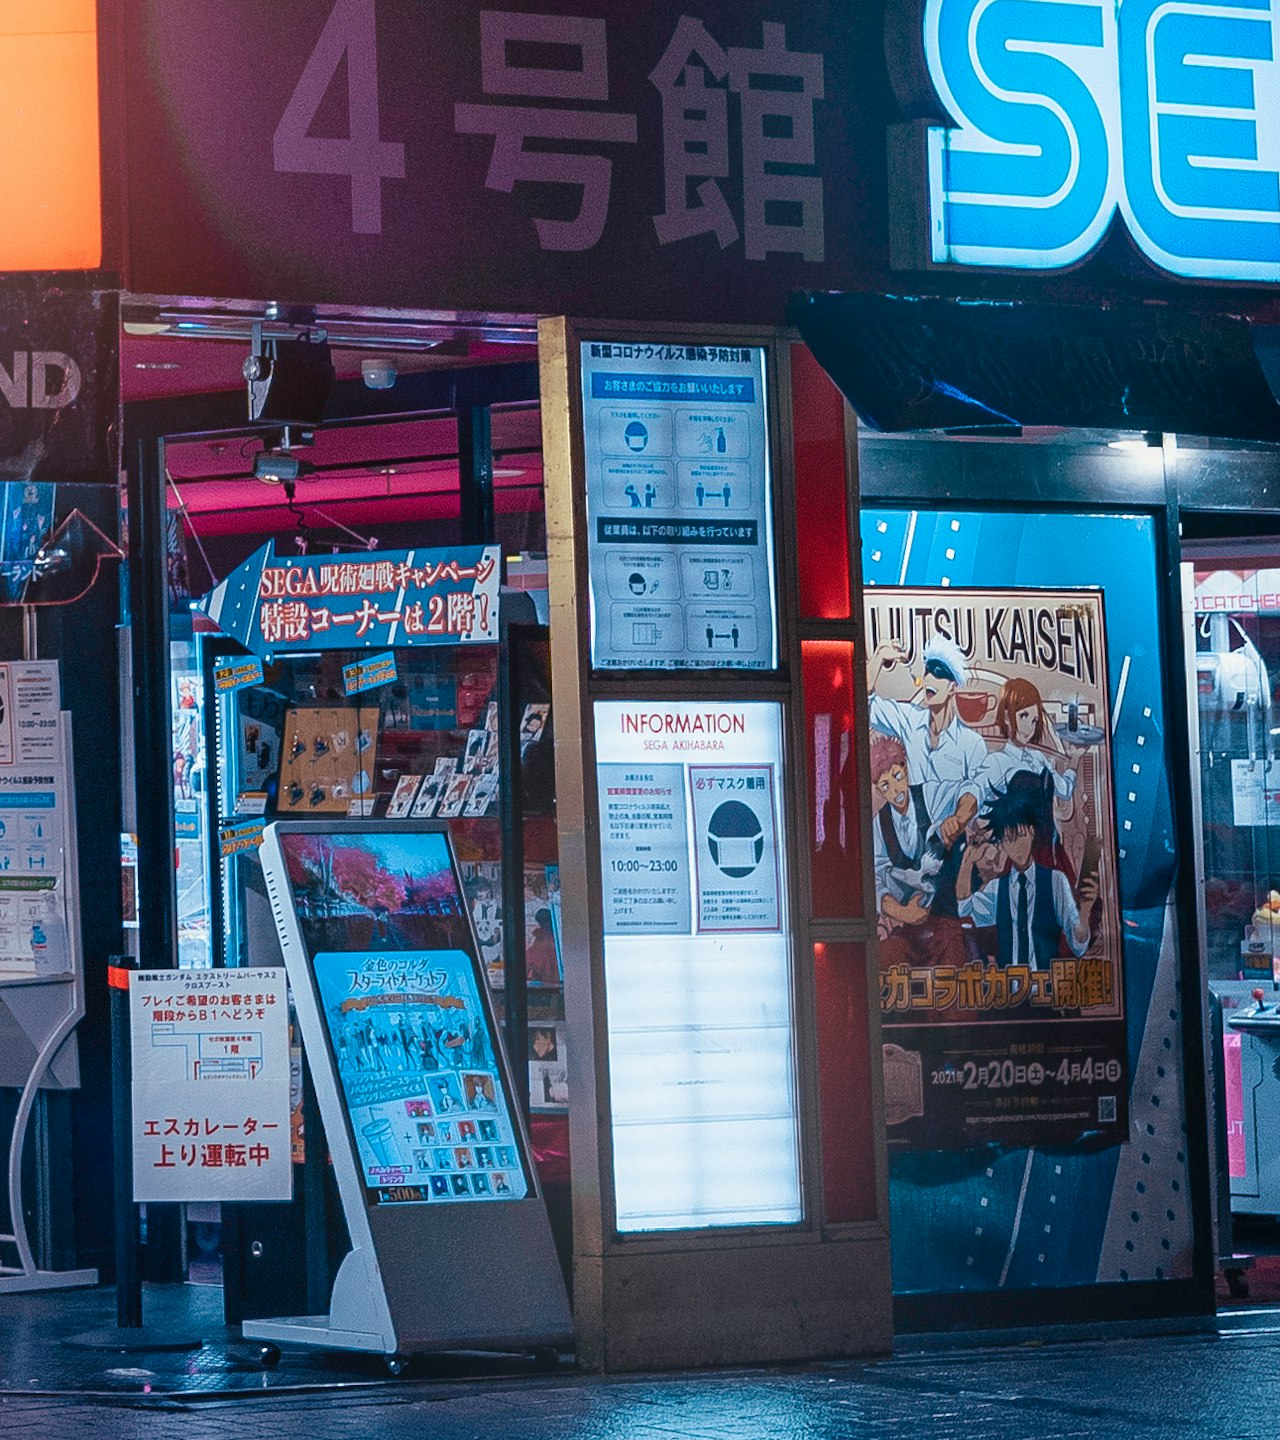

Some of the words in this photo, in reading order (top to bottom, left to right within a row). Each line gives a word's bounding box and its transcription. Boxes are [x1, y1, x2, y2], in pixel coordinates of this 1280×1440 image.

[986, 608, 1097, 685] KAISEN
[621, 713, 745, 734] INFORMATION
[643, 739, 668, 751] SEGA
[672, 739, 724, 751] AKIHABARA
[696, 777, 765, 790] 必ずマスク着用
[878, 958, 1115, 1012] ガコラボカフェ開催!
[142, 993, 276, 1007] プレイご希望のお客さまは
[143, 1116, 279, 1138] エスカレーター
[153, 1142, 270, 1170] 上り運転中
